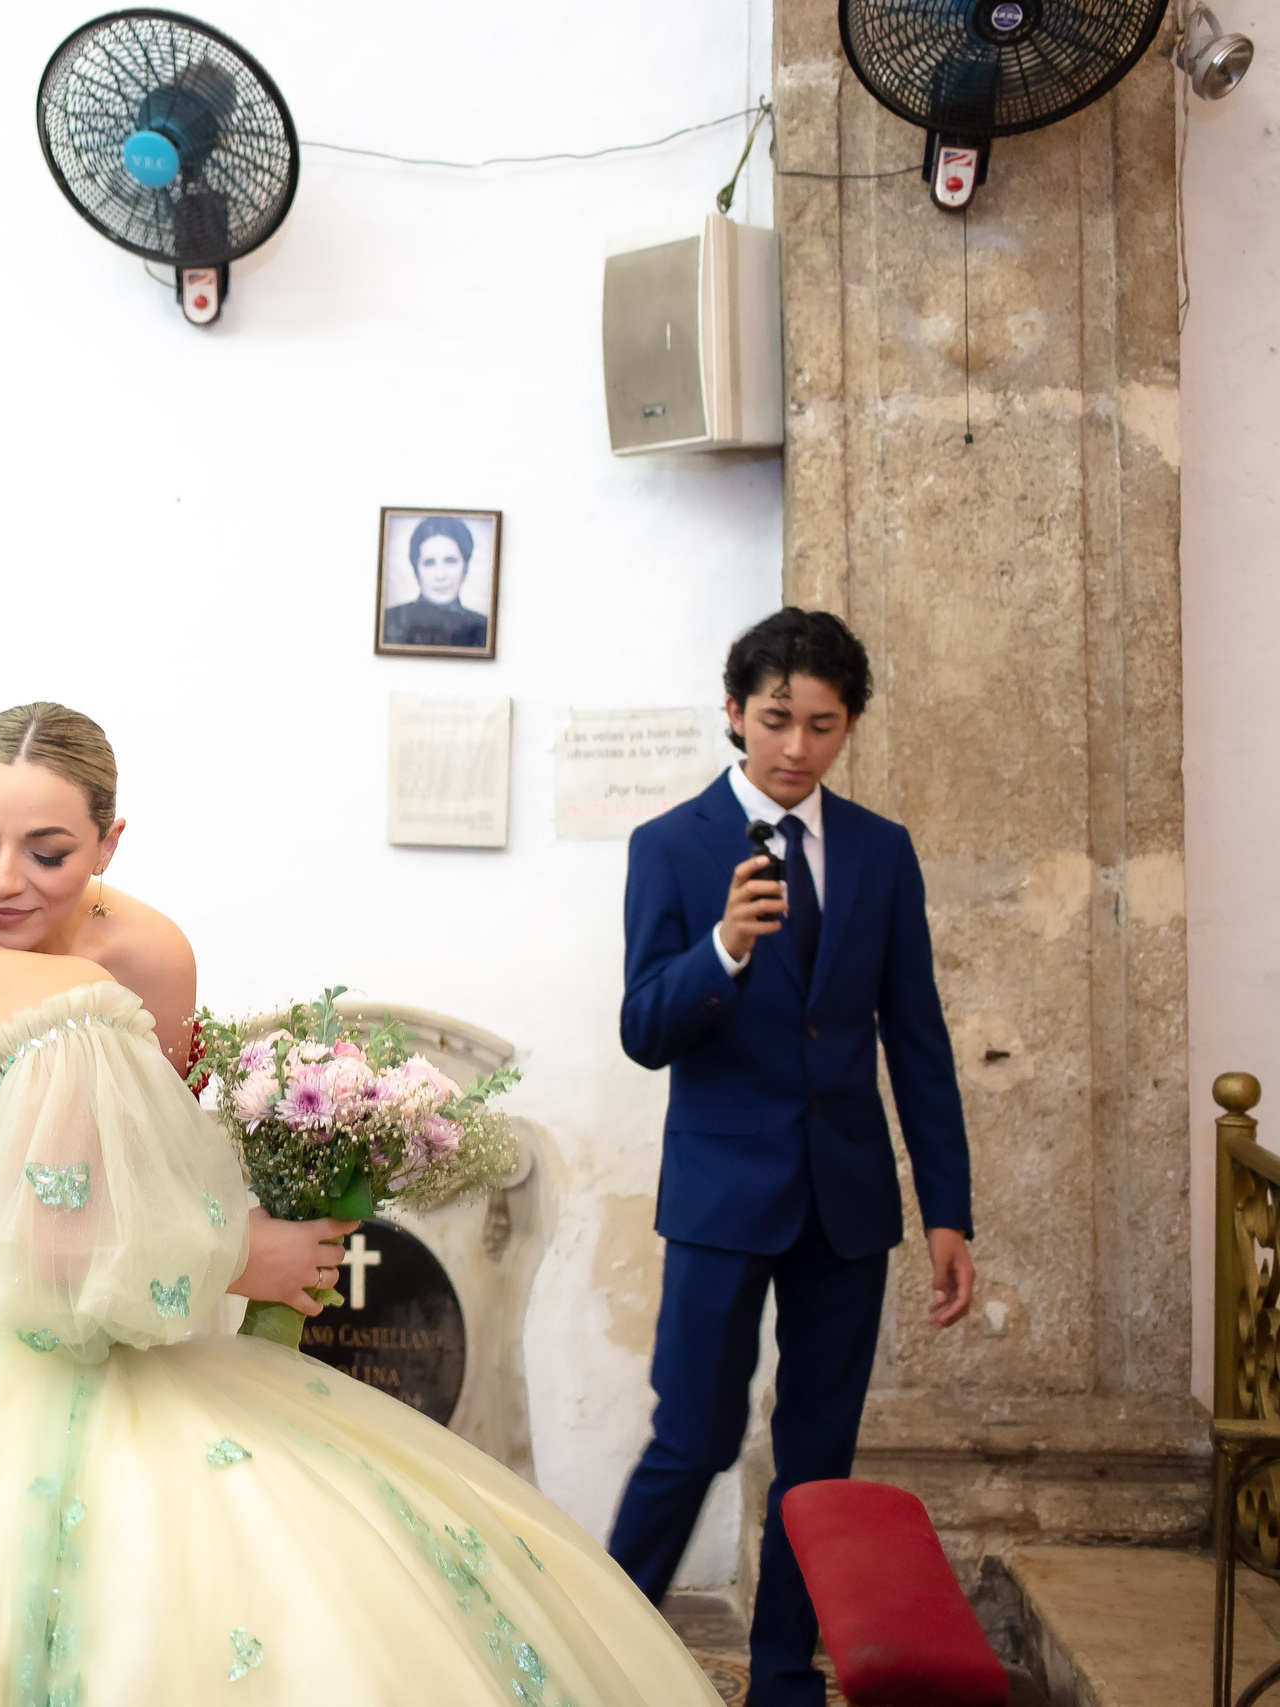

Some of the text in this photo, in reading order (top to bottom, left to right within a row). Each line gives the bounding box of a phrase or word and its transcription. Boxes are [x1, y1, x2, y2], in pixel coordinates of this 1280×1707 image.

[564, 731, 587, 743] Las
[628, 749, 637, 759] a
[639, 746, 652, 758] la
[655, 744, 697, 759] Virgen
